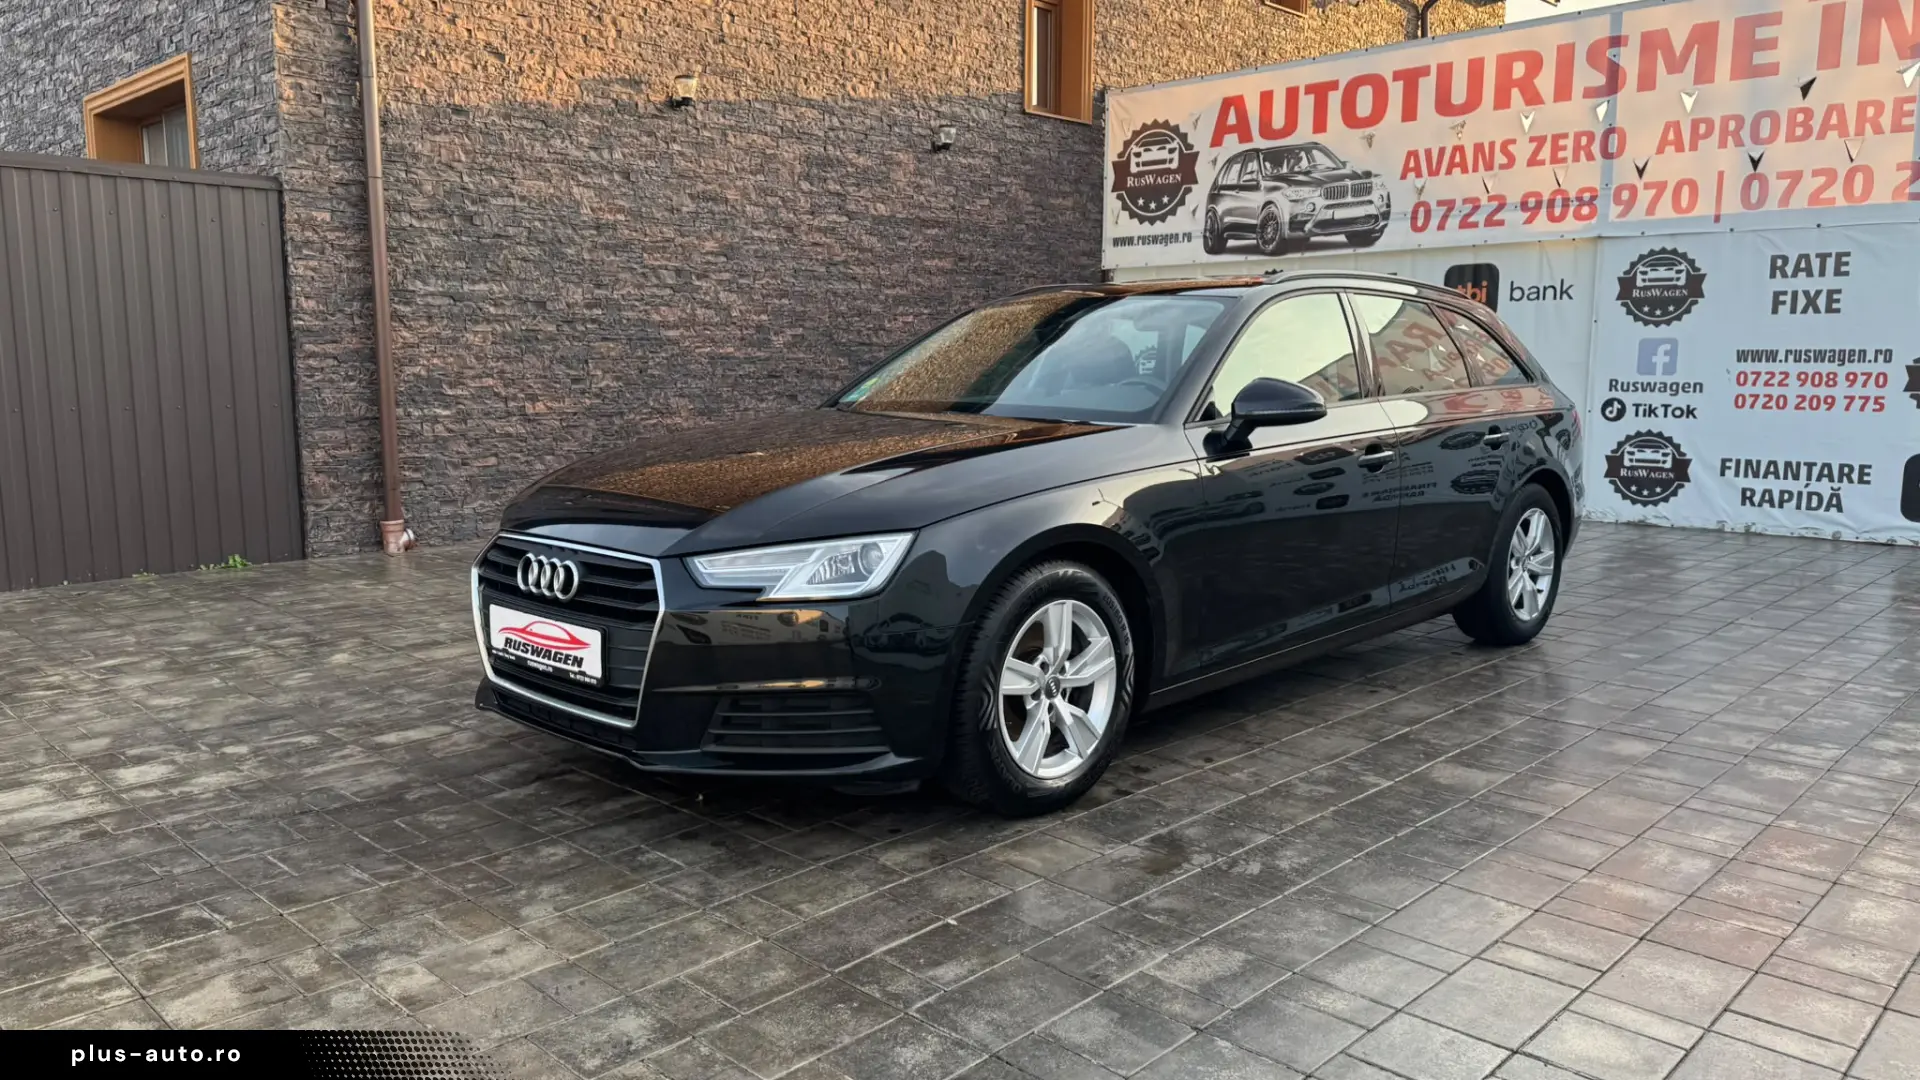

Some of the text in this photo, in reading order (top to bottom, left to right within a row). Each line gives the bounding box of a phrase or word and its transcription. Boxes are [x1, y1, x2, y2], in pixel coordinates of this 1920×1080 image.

[1209, 11, 1783, 148] AUTOTURISME
[1399, 95, 1916, 181] AVANS ZERO APROBARE
[1409, 194, 1508, 233] 0722
[1519, 186, 1599, 226] 908
[1612, 177, 1700, 219] 970
[1739, 164, 1875, 211] 0720
[1112, 231, 1193, 248] www.ruswagen.ro
[1768, 251, 1852, 280] RATE
[1508, 278, 1575, 302] bank
[1770, 288, 1843, 316] FIXE
[1736, 348, 1893, 368] www.ruswagen.ro
[1608, 378, 1704, 397] Ruswagen
[1735, 370, 1889, 389] 0722 908 970
[1632, 403, 1698, 420] TikTok
[1734, 393, 1886, 412] 0720 209 775
[1740, 485, 1844, 513] RAPIDĂ
[504, 637, 584, 669] RUSWAGEN
